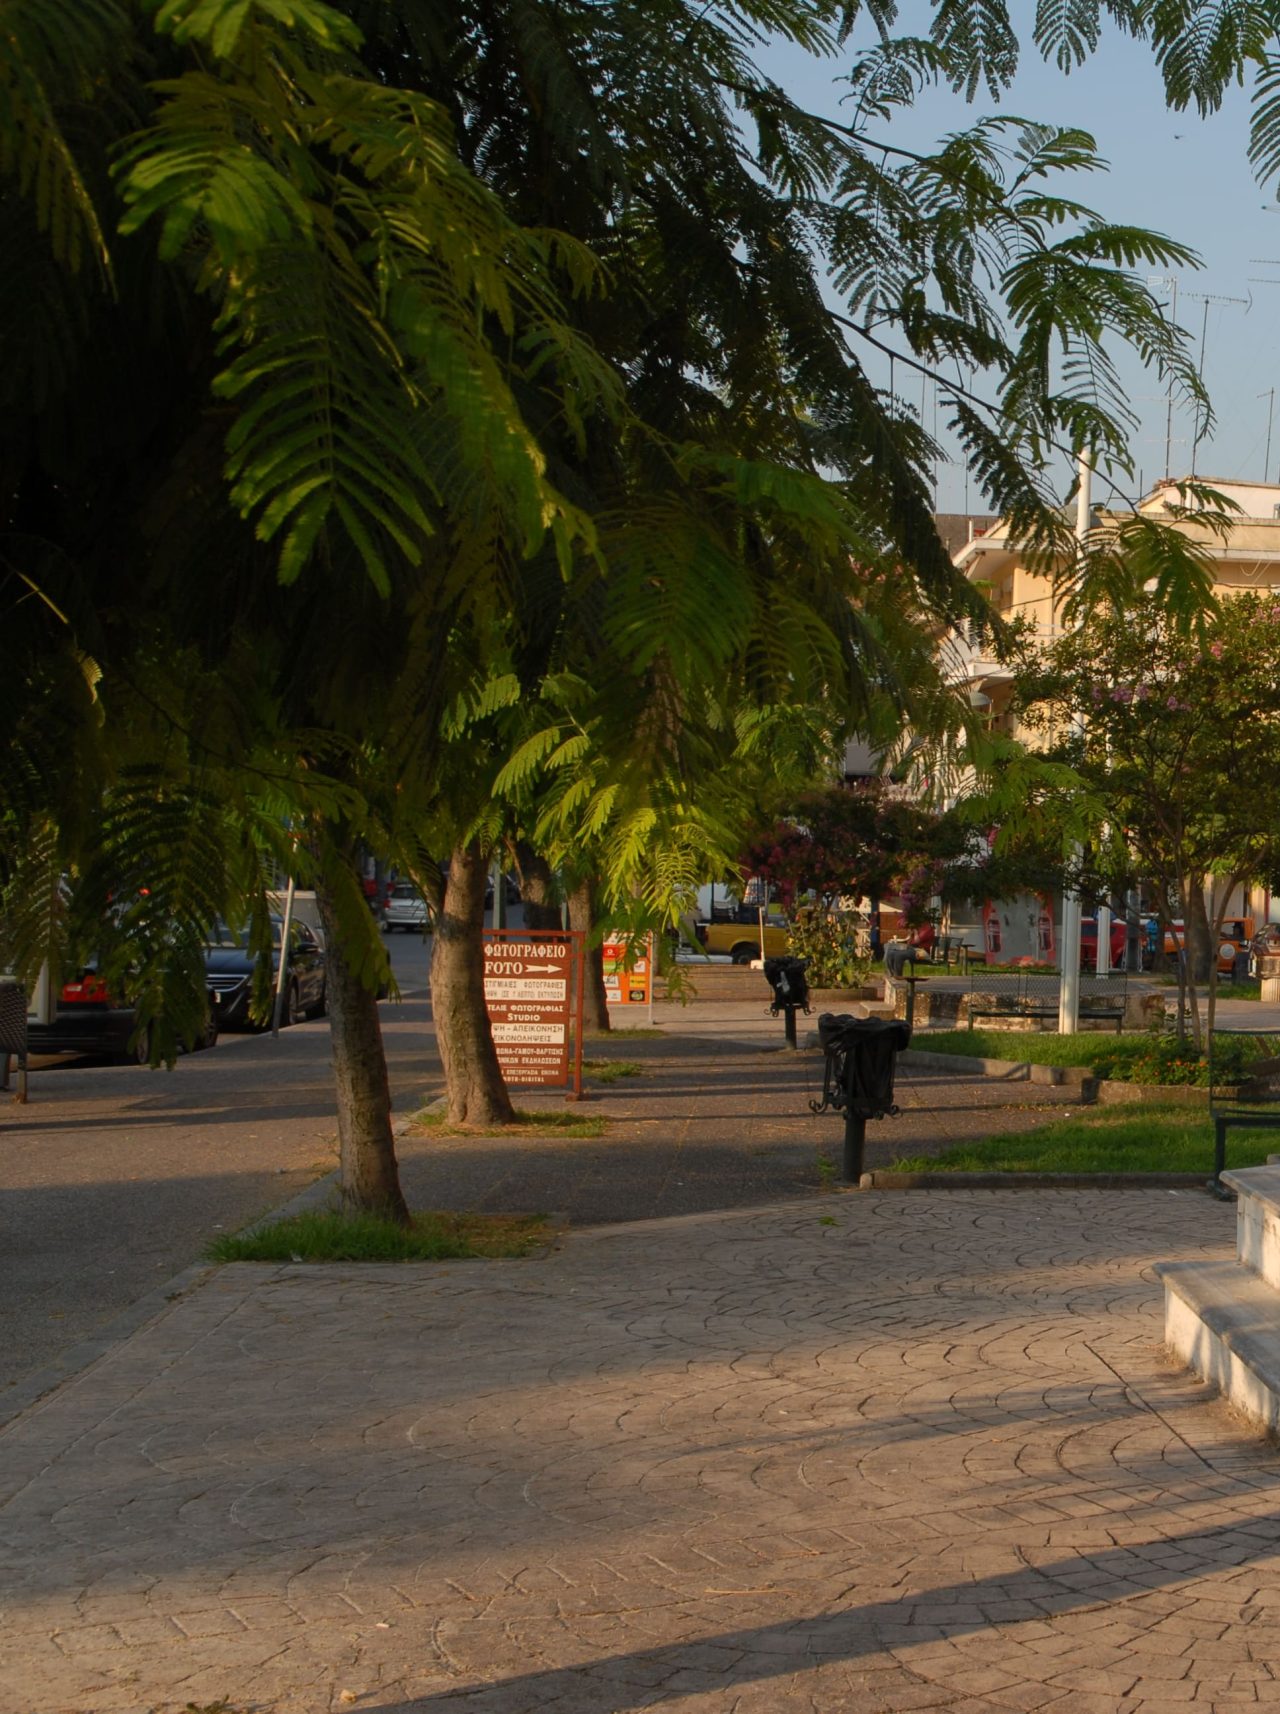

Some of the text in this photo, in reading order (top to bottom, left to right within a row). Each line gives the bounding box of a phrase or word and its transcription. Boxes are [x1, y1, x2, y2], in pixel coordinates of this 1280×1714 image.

[484, 944, 566, 958] ΦΩΤΟΓΡΑΦΕΙΟ
[484, 961, 523, 975] FOTO
[510, 1004, 563, 1012] ΦΩΤΟΓΡΑΦΙΑΣ
